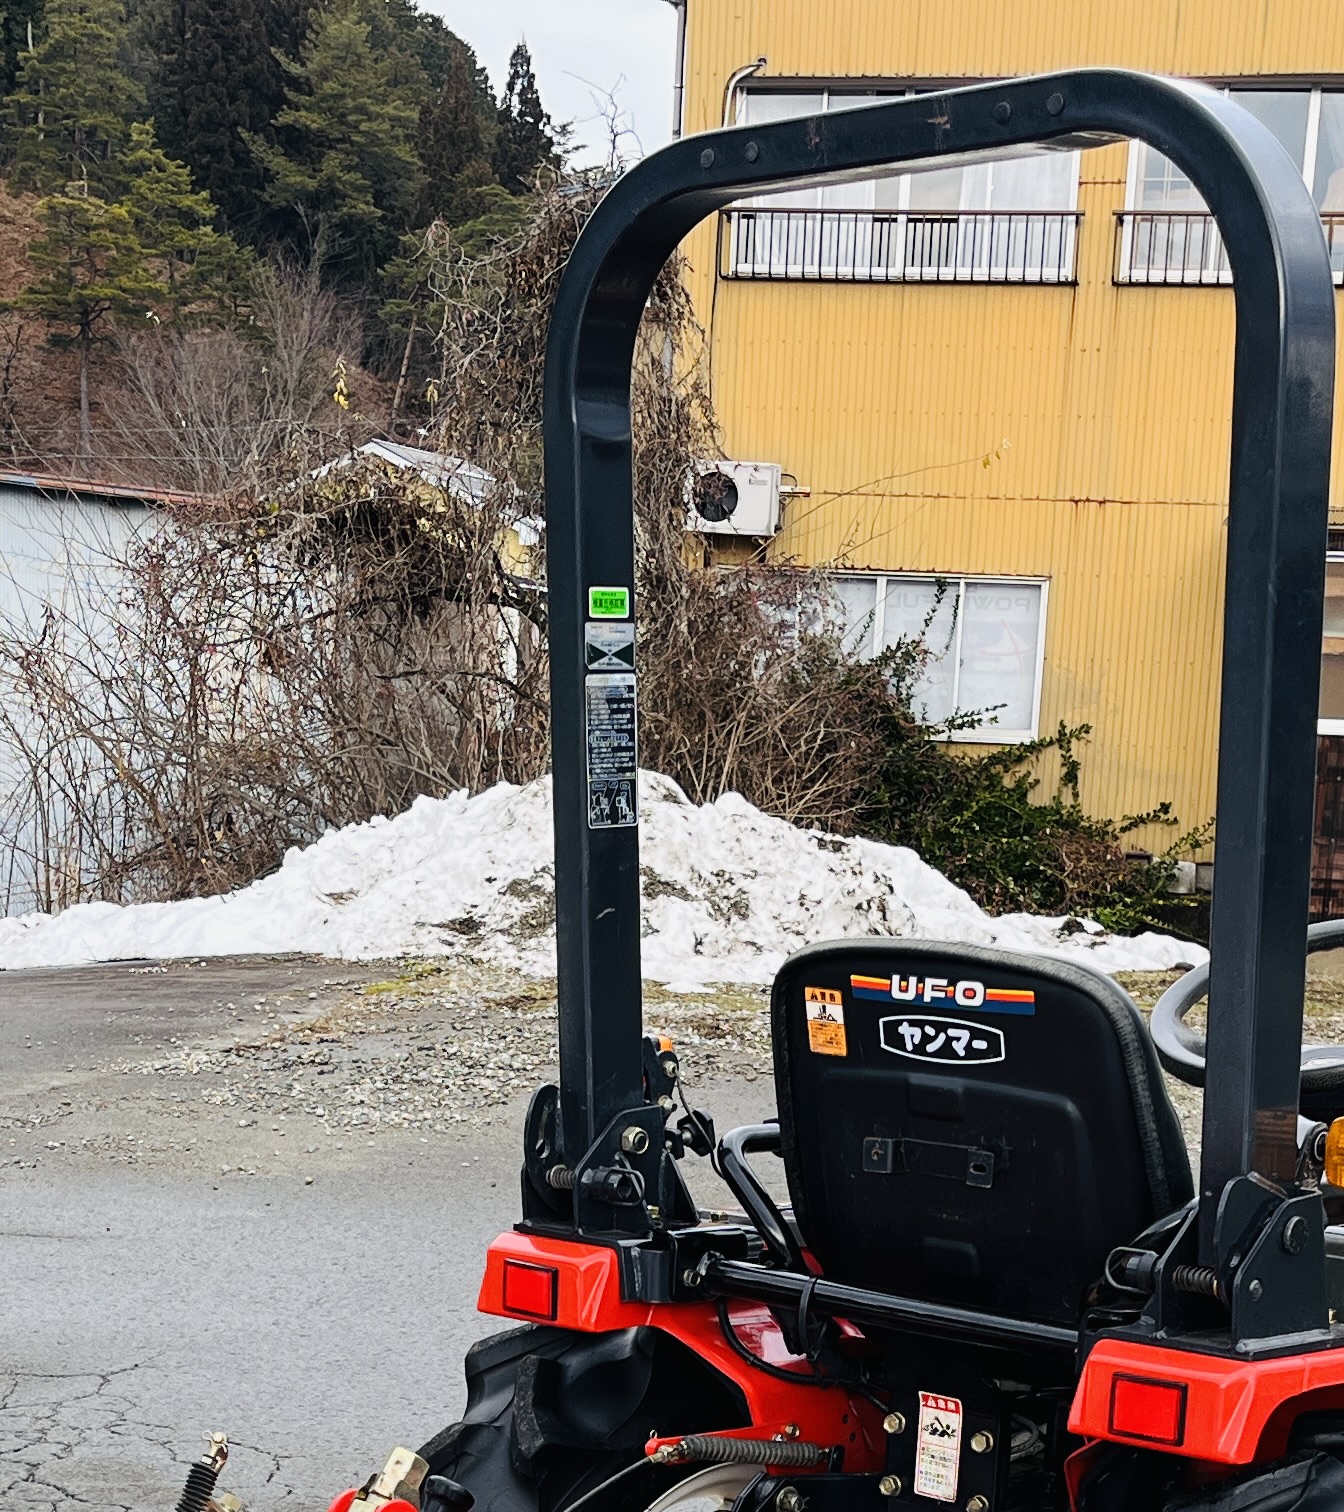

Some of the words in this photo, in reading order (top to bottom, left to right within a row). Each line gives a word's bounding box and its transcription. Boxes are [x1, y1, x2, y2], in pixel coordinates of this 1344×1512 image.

[890, 973, 985, 1007] UFO
[897, 1020, 990, 1057] ヤンマー
